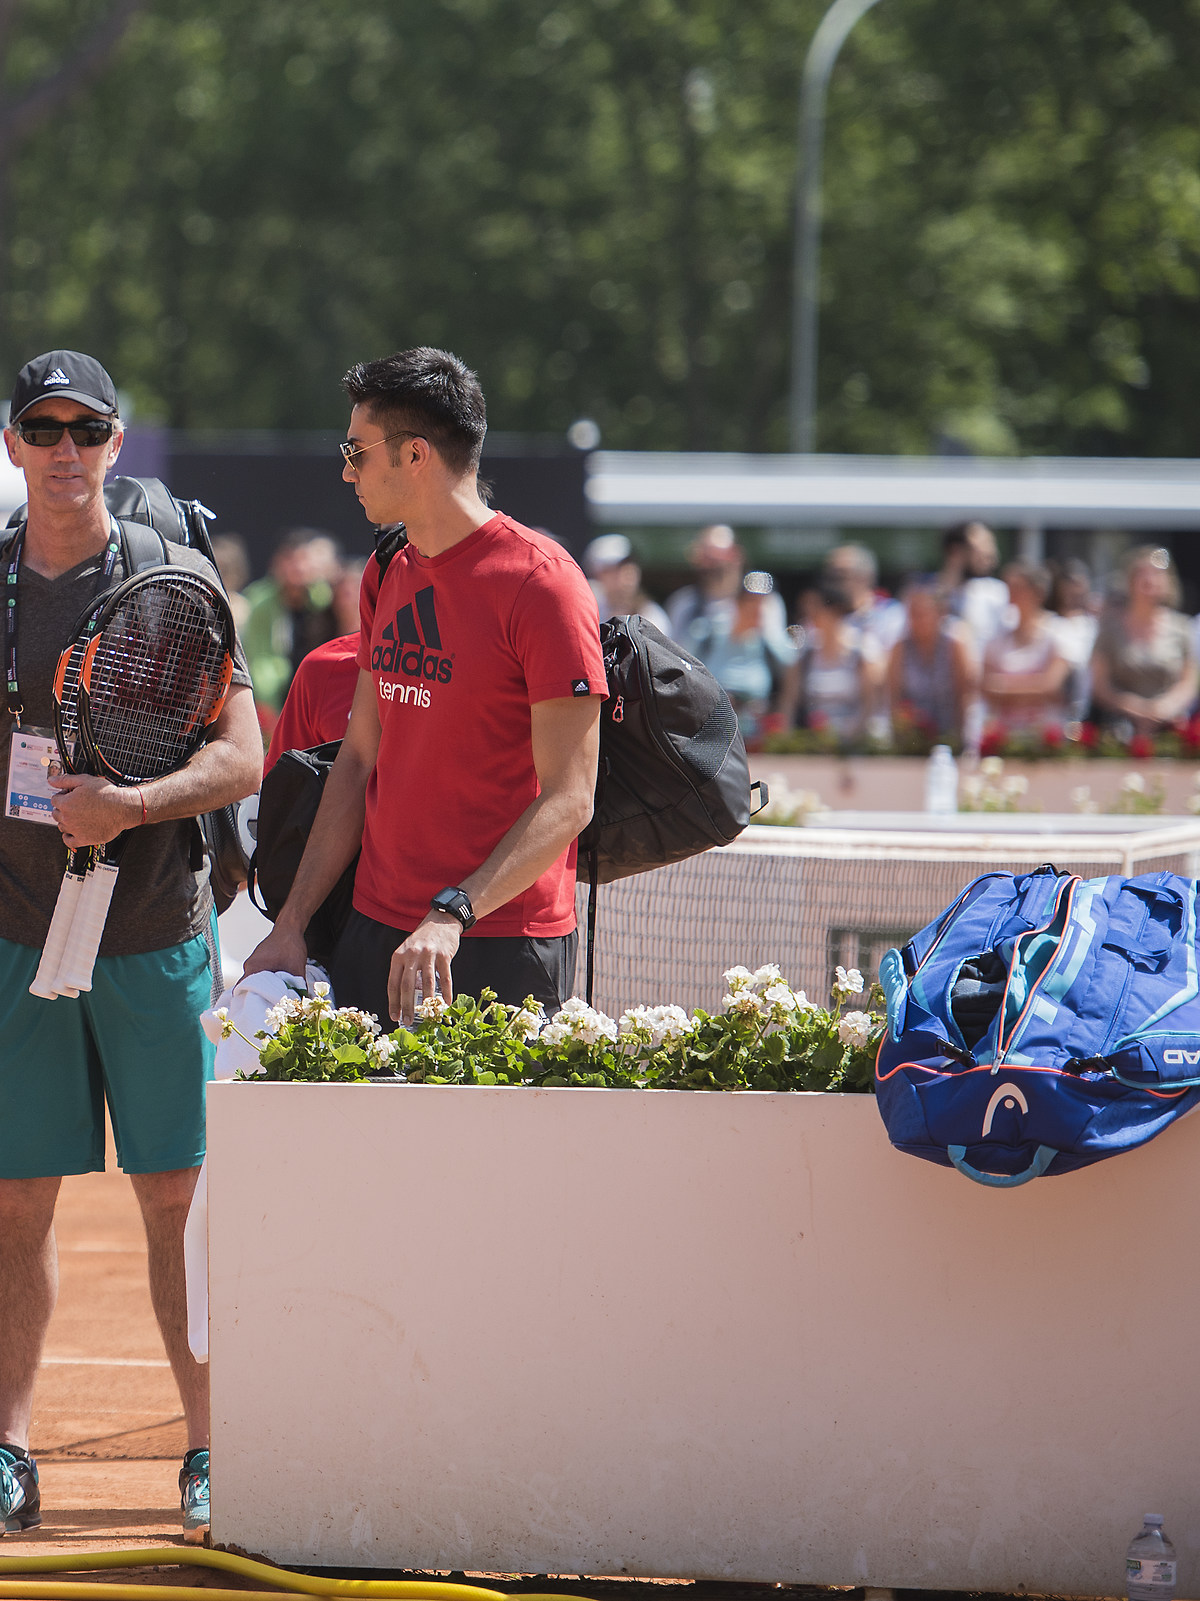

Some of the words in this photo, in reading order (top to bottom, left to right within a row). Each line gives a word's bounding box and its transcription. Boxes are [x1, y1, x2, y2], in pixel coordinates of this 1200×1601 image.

[43, 377, 70, 386] adidas
[371, 639, 453, 684] adidas
[378, 676, 432, 708] tennis
[1163, 1049, 1200, 1065] AD
